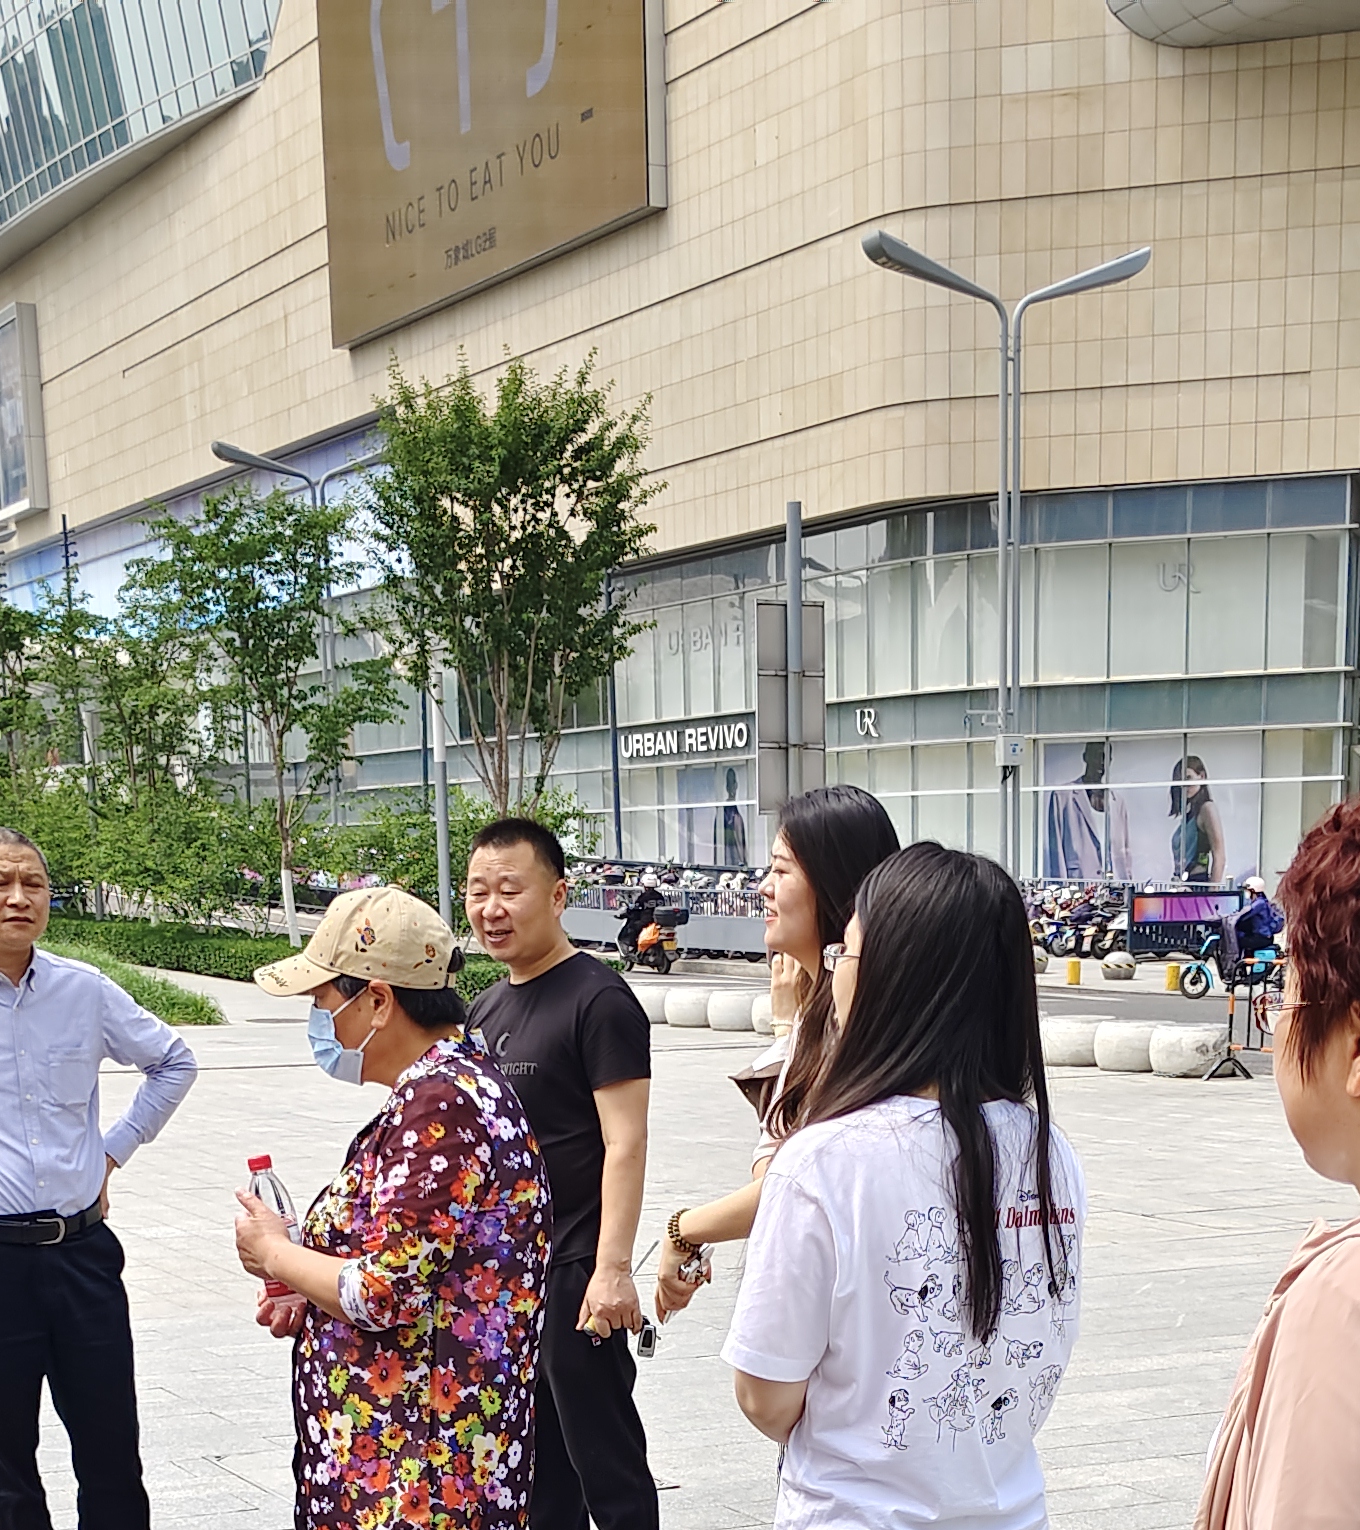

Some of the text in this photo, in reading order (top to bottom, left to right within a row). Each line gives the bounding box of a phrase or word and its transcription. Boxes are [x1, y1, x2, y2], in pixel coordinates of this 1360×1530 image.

[385, 122, 561, 245] NICE TO EAT YOU
[620, 722, 749, 759] URBAN REVIVO
